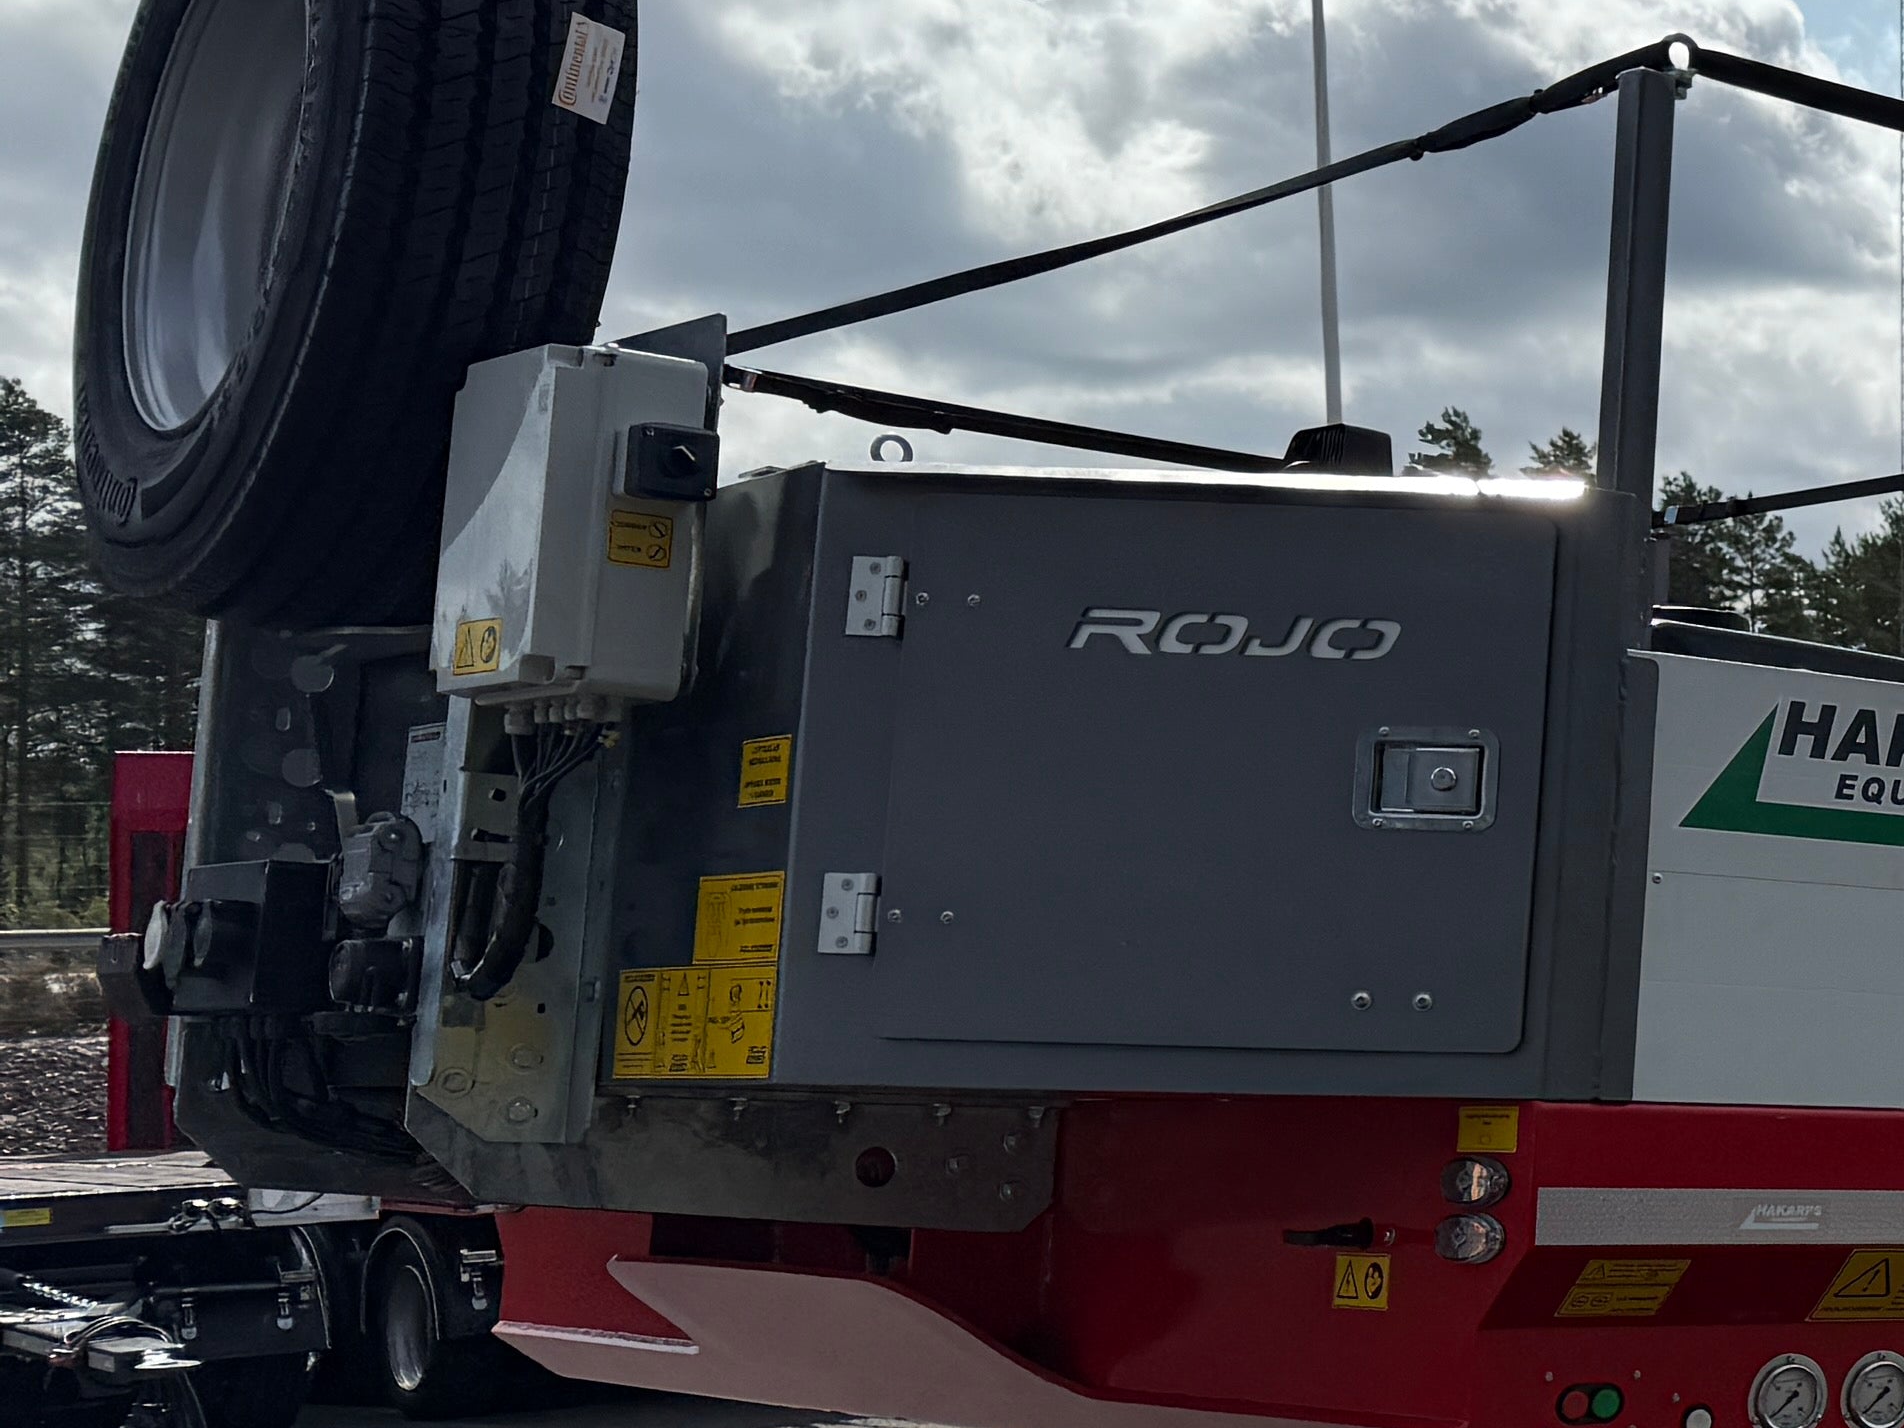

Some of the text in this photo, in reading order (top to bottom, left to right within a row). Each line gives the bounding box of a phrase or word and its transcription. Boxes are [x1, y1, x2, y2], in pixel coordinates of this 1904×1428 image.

[558, 30, 588, 107] Continental
[1067, 605, 1402, 661] ROJO
[1755, 1203, 1823, 1217] HAKARPS
